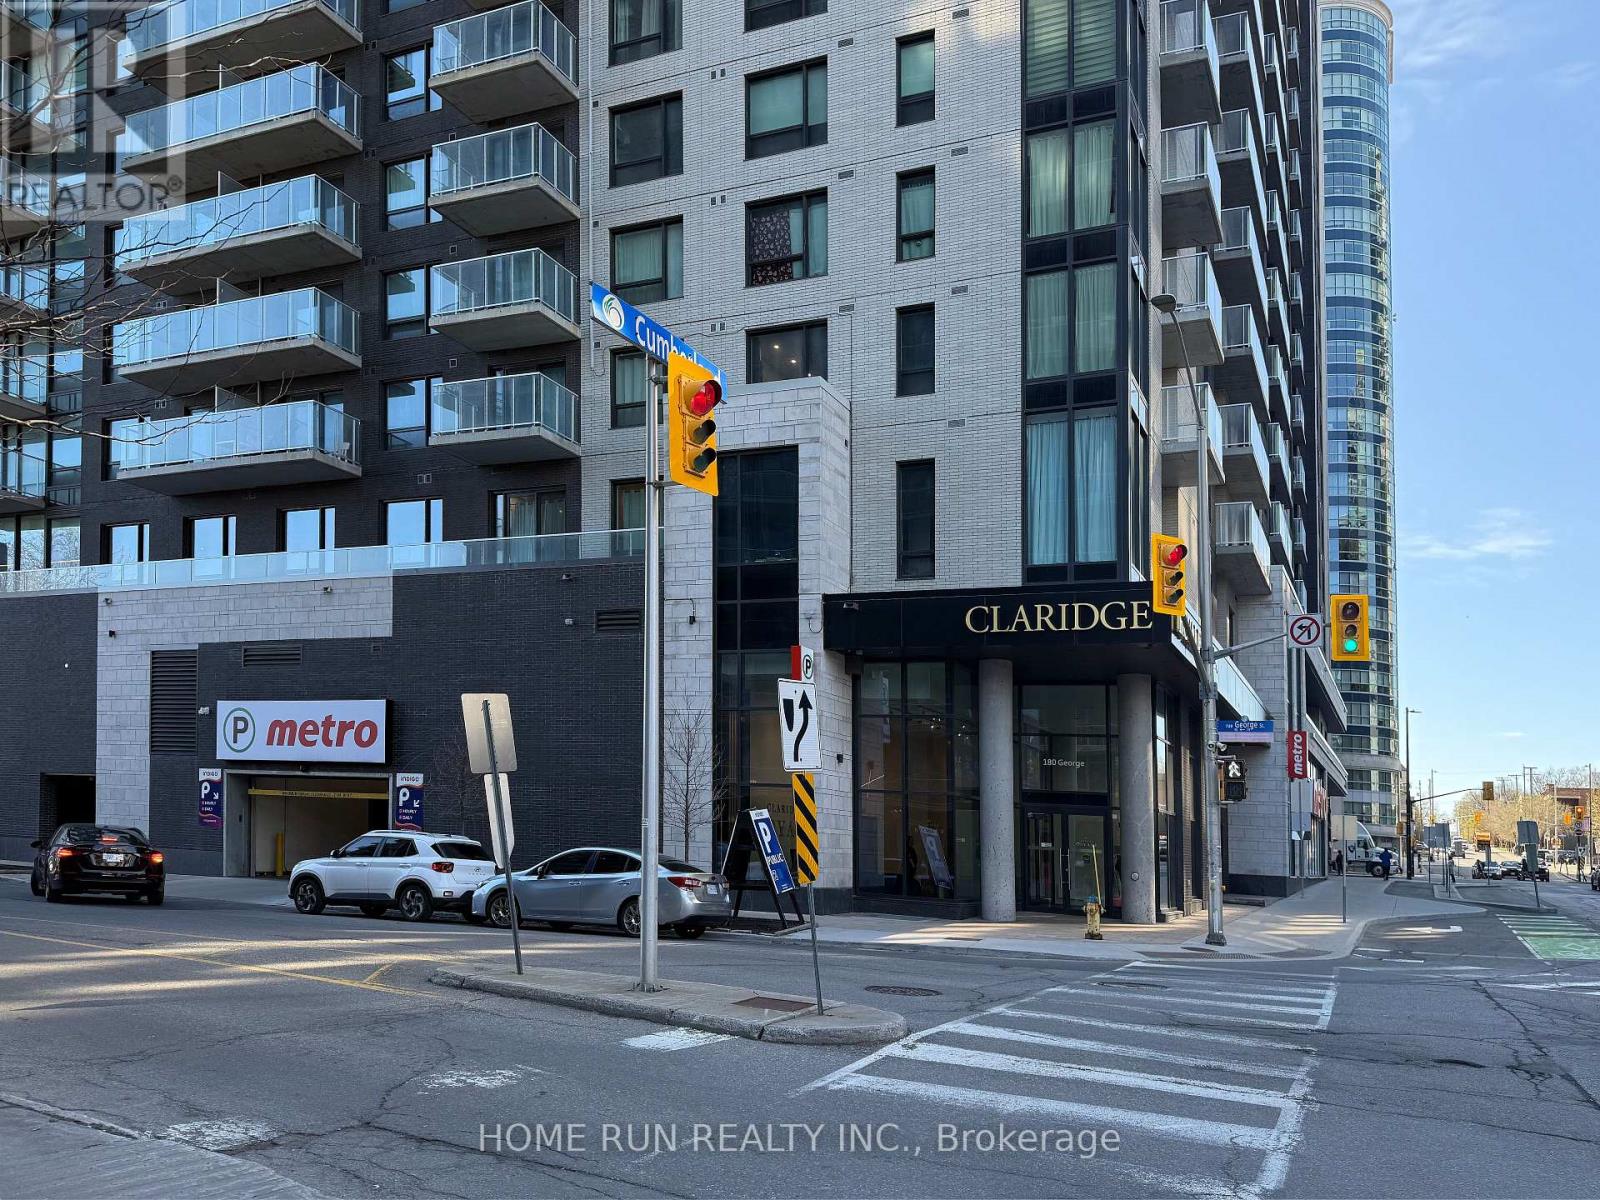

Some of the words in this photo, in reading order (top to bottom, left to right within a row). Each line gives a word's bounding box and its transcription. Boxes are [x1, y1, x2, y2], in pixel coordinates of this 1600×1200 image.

[965, 601, 1153, 633] CLARIDGE
[233, 716, 249, 744] P
[266, 714, 378, 748] metro
[1234, 720, 1258, 729] George
[1042, 758, 1056, 766] 180
[1057, 758, 1085, 769] George
[1292, 733, 1303, 775] metro
[201, 781, 210, 799] P
[399, 787, 410, 807] P
[758, 821, 772, 854] P
